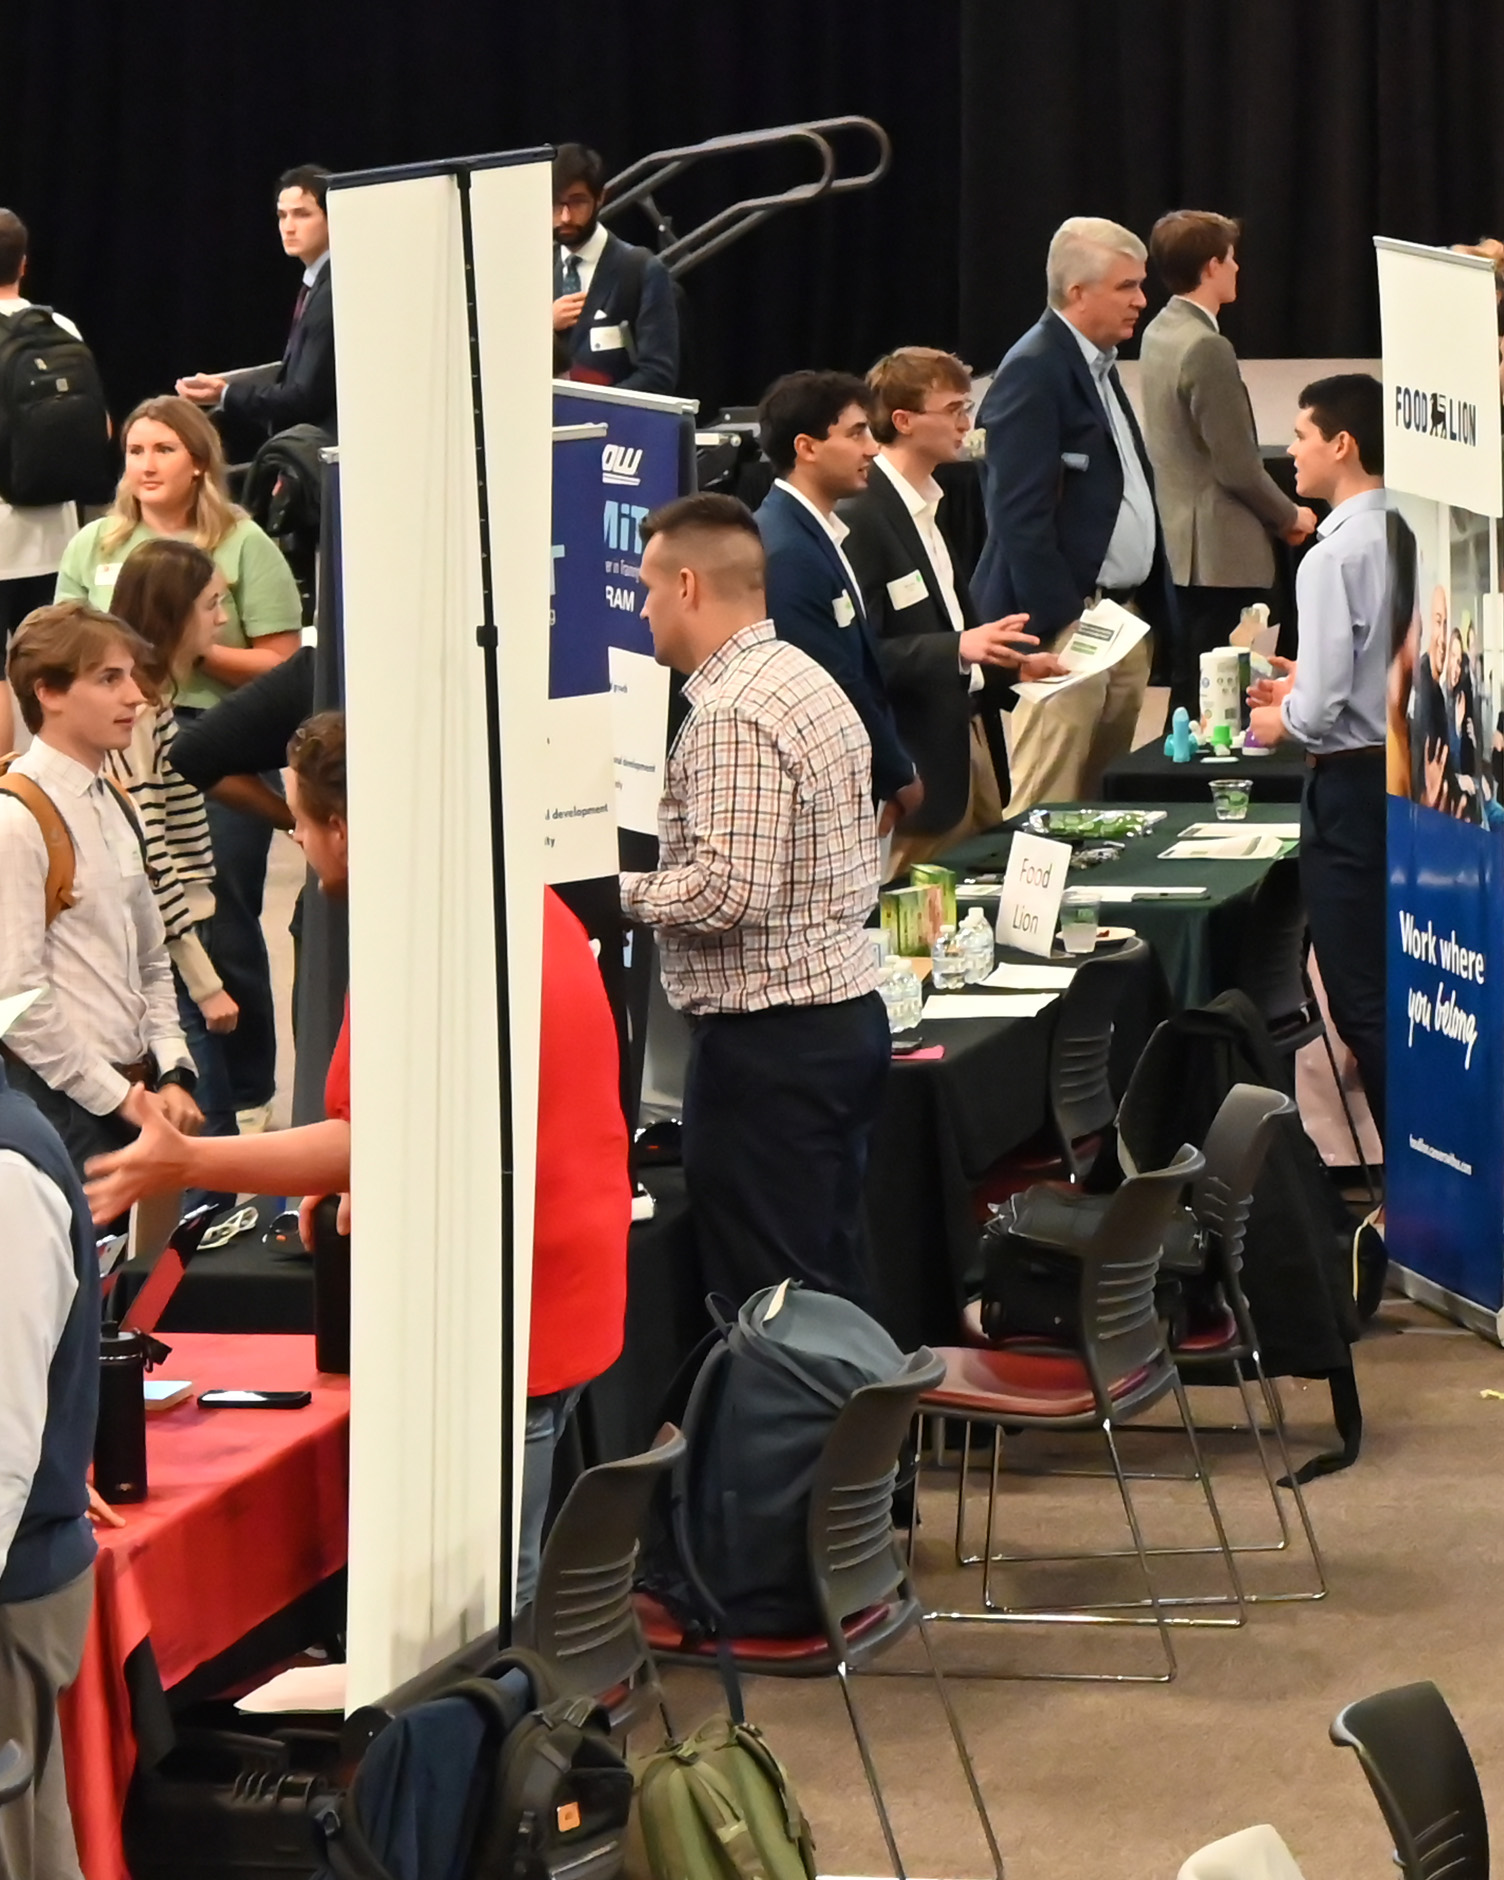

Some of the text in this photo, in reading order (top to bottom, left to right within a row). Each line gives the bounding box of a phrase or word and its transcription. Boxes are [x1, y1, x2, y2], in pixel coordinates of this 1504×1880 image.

[1396, 385, 1477, 447] FOOD LION
[552, 803, 609, 820] development
[1020, 858, 1052, 889] Food
[1012, 904, 1039, 935] Lion
[1399, 910, 1485, 985] Work where
[1407, 982, 1478, 1071] you belong
